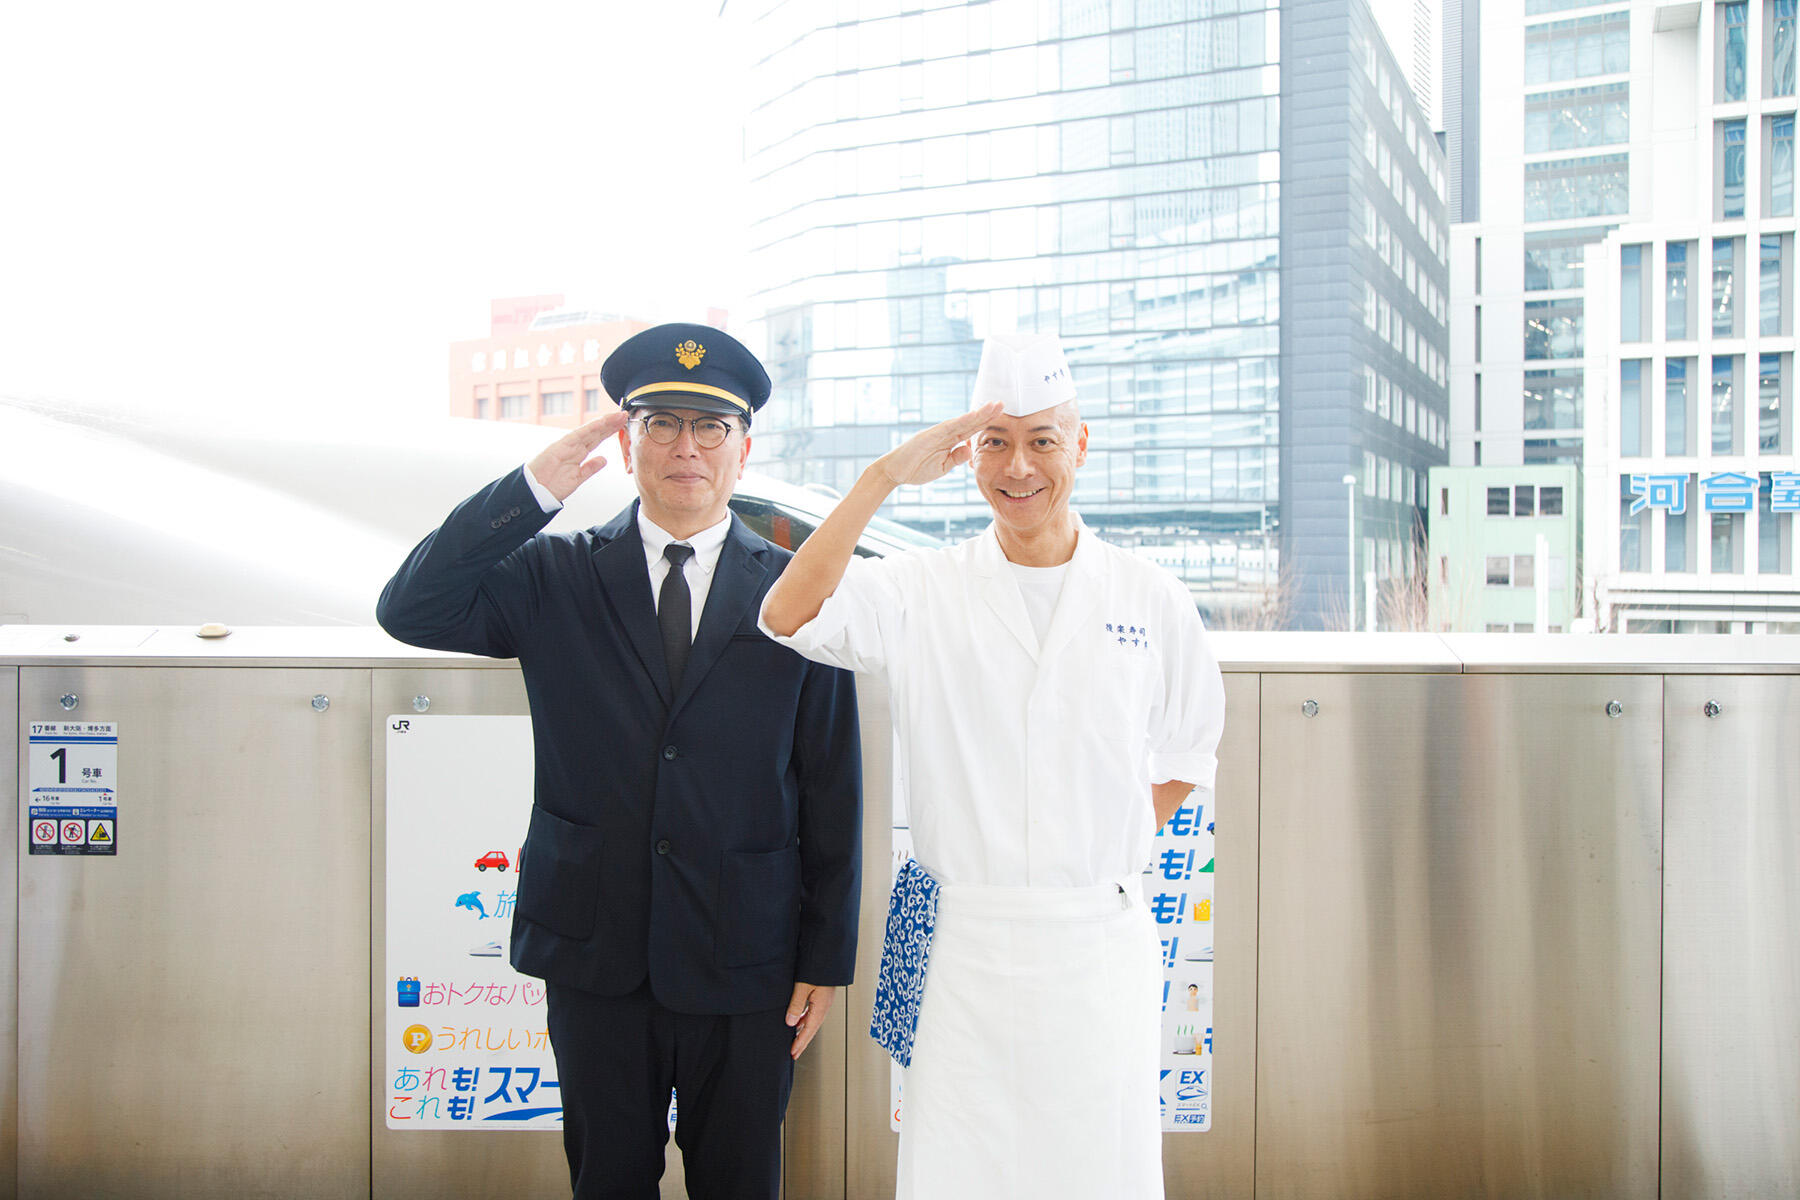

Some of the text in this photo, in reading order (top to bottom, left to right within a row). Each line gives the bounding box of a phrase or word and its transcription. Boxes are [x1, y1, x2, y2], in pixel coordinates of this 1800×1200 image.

[392, 720, 410, 731] JR
[50, 748, 102, 784] 1 号車
[1159, 849, 1195, 880] も!
[1151, 893, 1187, 924] も!
[394, 1066, 480, 1092] あれも!
[1179, 1071, 1205, 1084] EX
[389, 1095, 476, 1121] これも!
